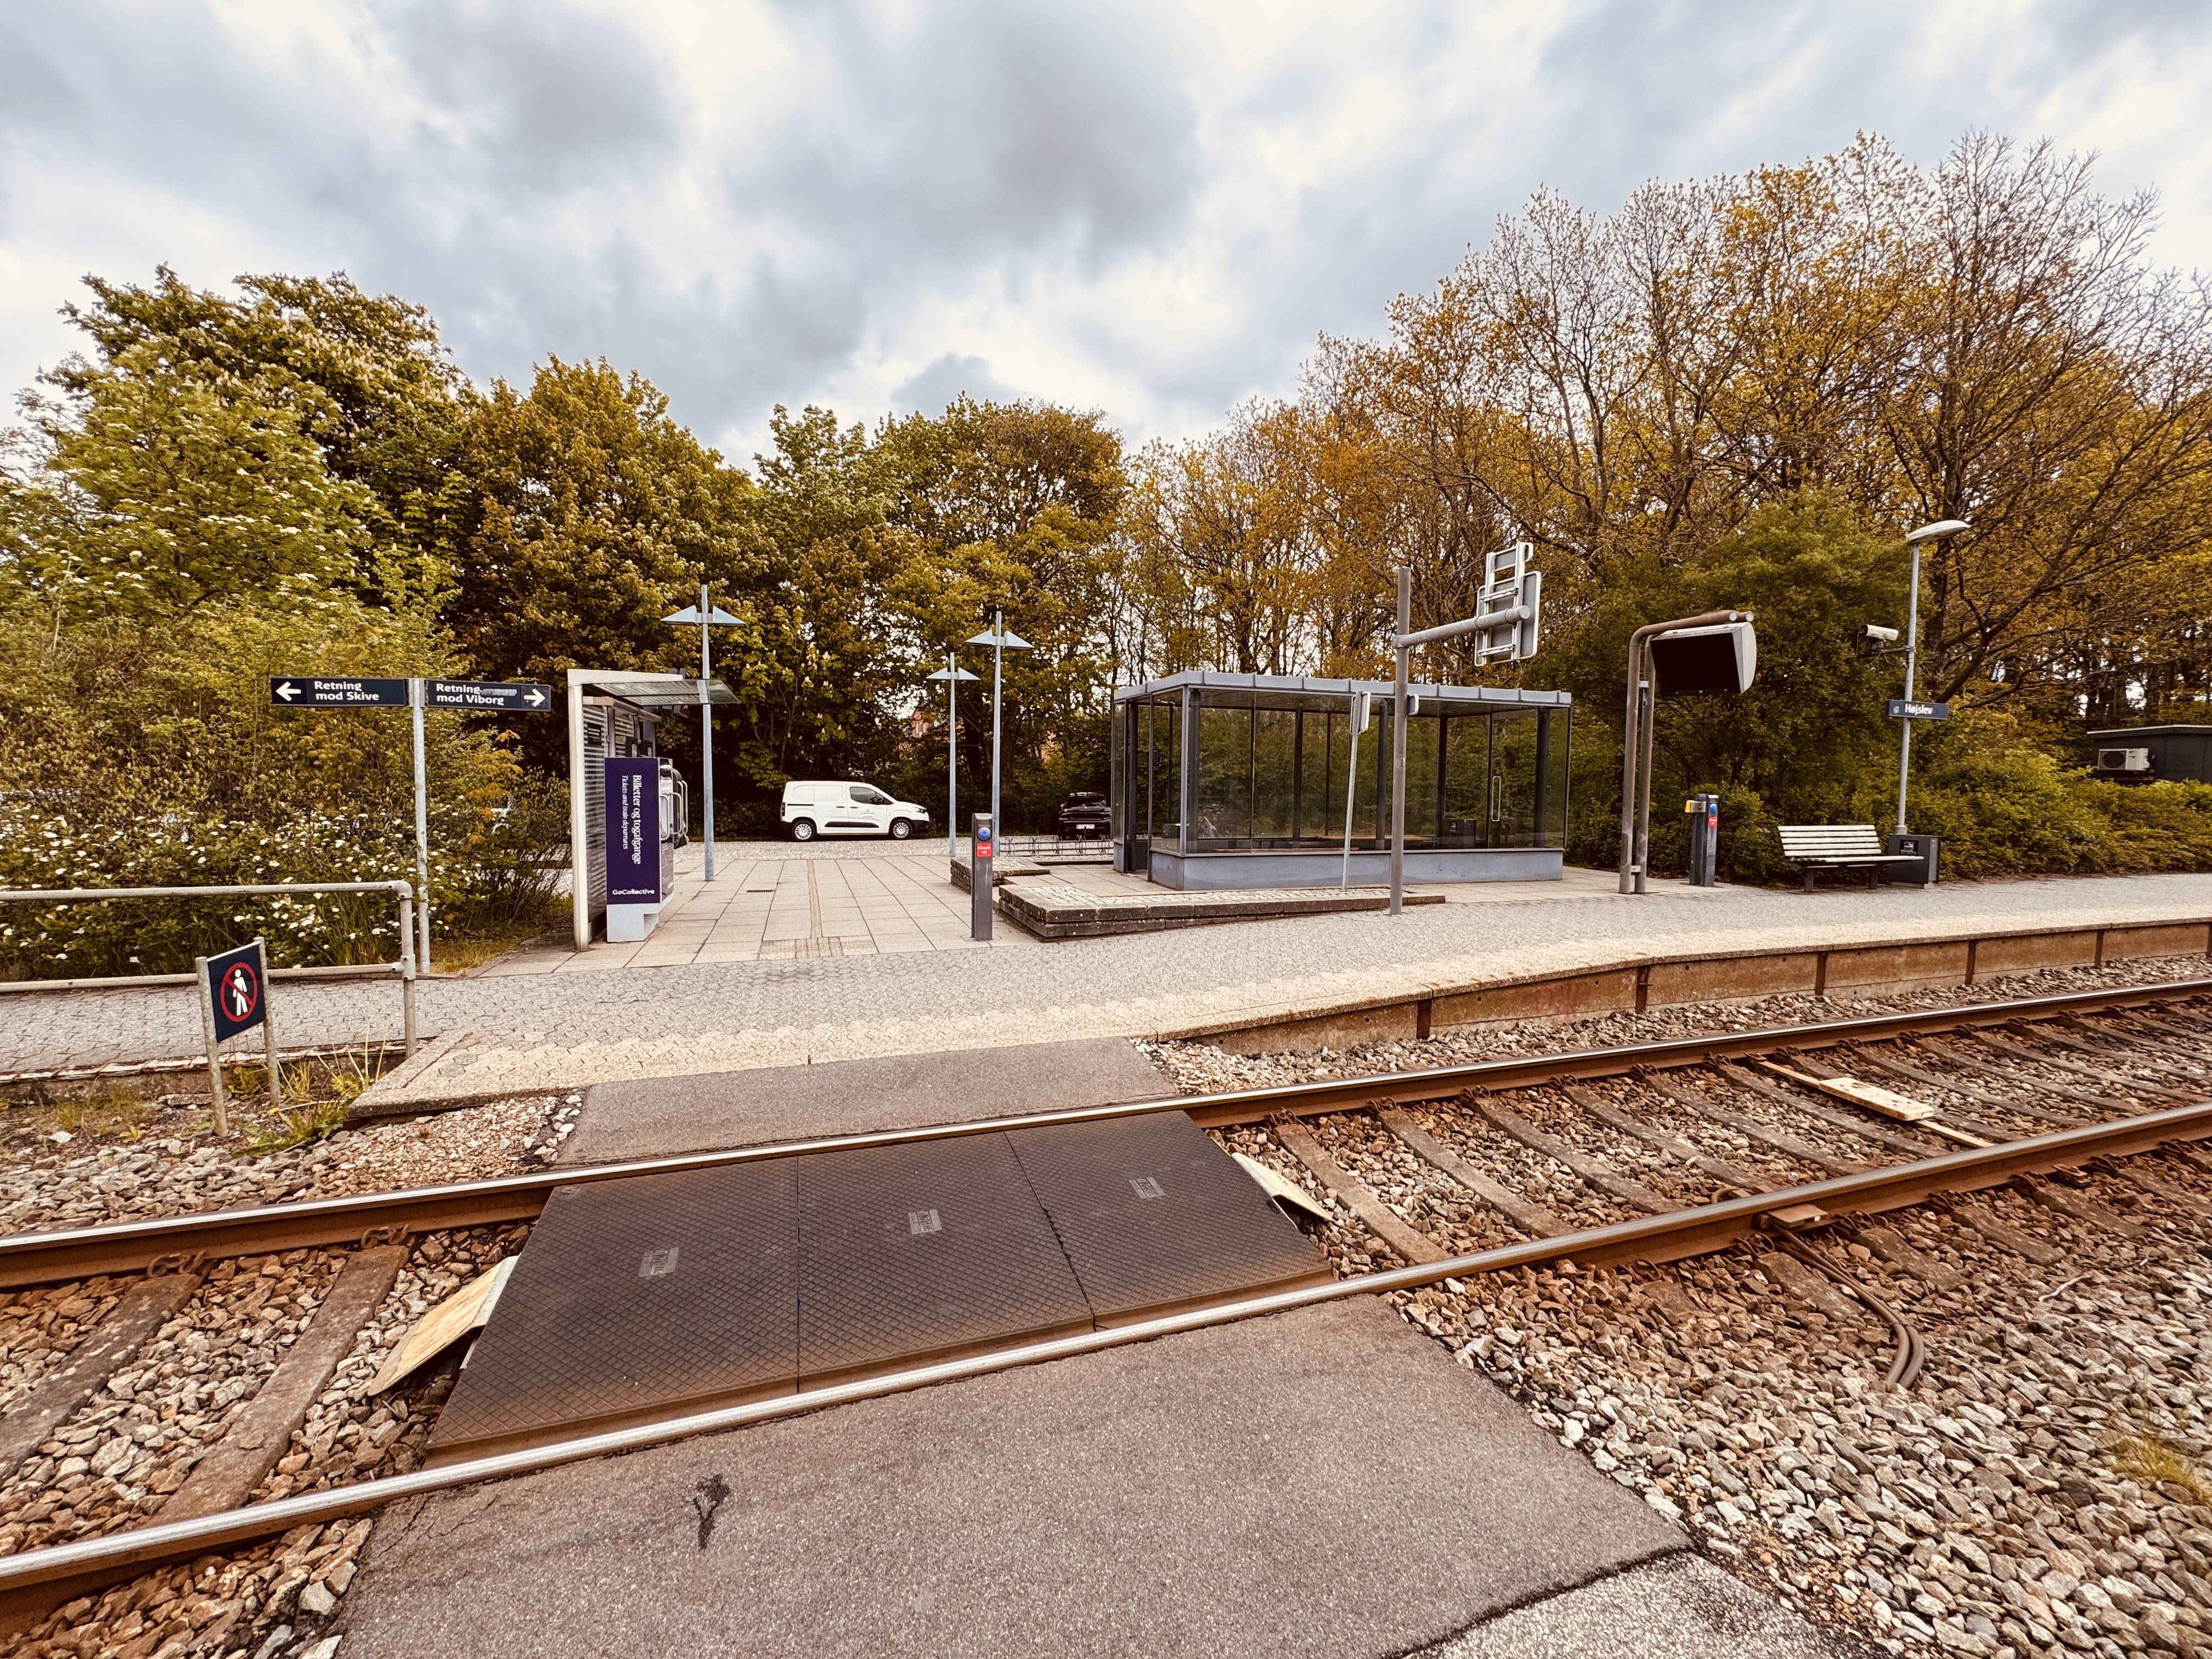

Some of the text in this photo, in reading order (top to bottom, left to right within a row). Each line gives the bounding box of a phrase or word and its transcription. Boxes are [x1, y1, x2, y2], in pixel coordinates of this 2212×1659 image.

[314, 681, 362, 691] Retning
[436, 683, 481, 695] Retning
[316, 692, 380, 701] mod Skive
[437, 695, 504, 706] mod Viborg
[1905, 703, 1933, 715] Højslev
[631, 775, 643, 865] Billetter og togafgange
